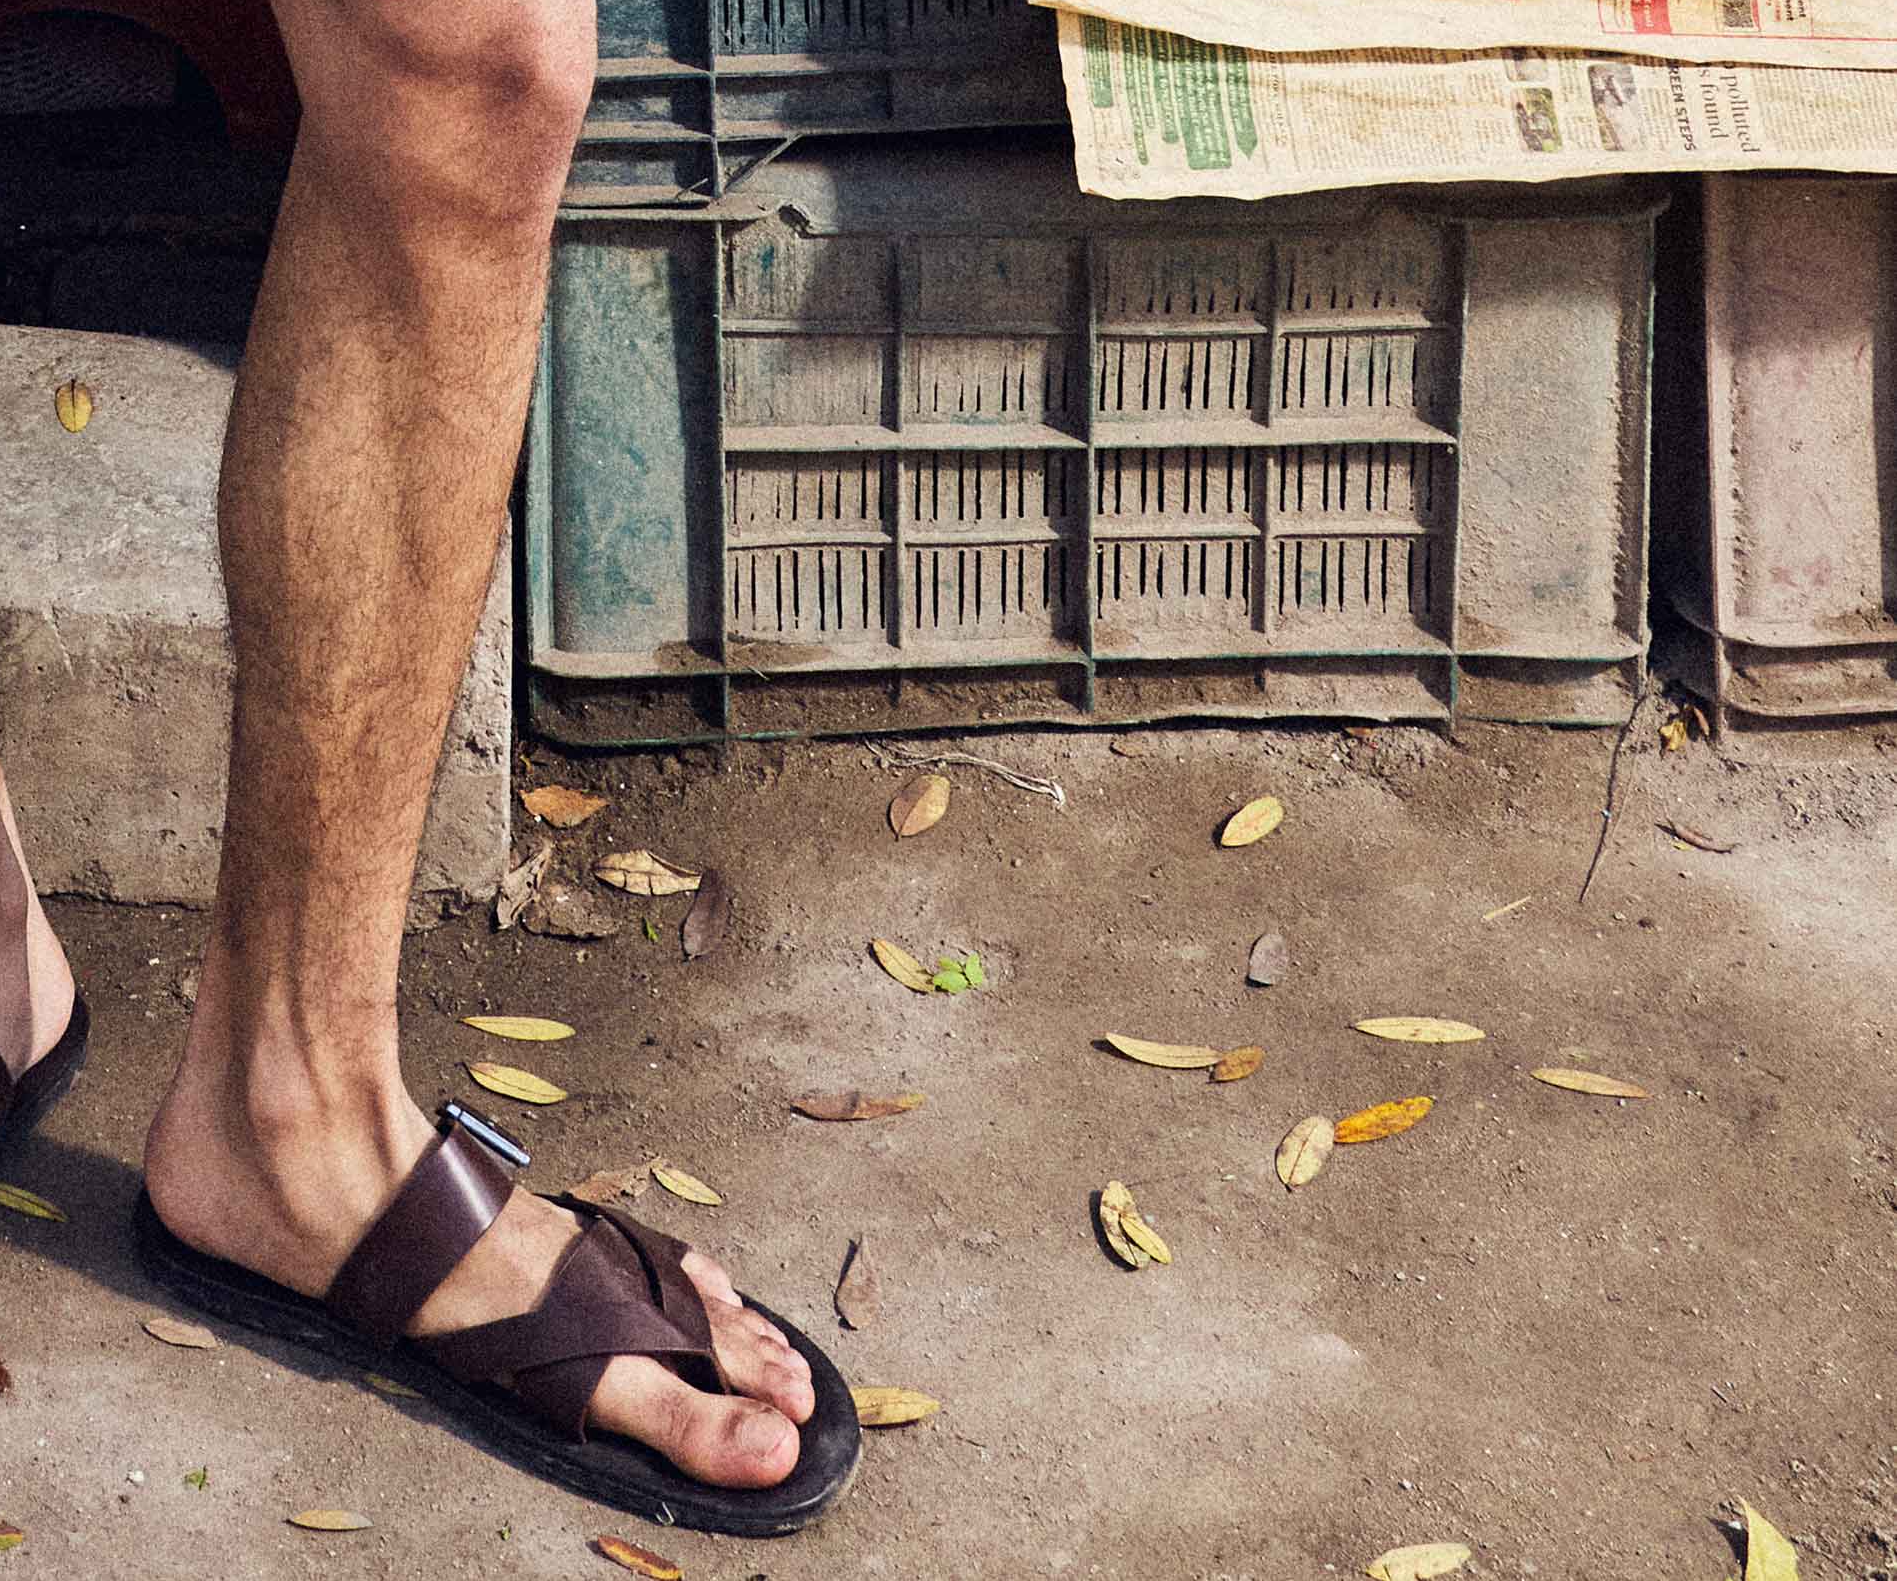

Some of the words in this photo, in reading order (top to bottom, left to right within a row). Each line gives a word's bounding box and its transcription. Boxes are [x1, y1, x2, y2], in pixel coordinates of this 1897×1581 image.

[1675, 108, 1697, 151] STEPS
[1699, 84, 1729, 139] found
[1719, 75, 1761, 152] polluted
